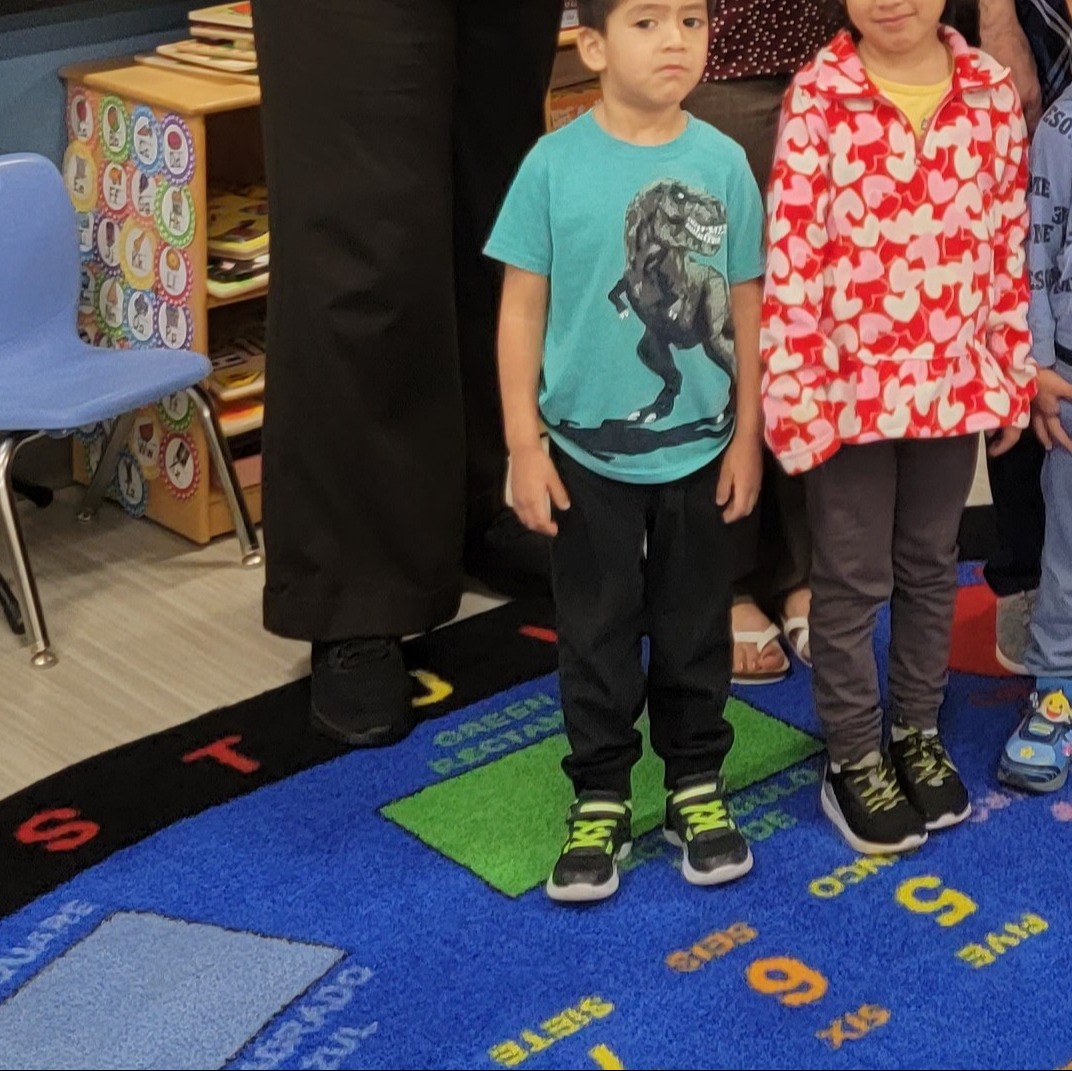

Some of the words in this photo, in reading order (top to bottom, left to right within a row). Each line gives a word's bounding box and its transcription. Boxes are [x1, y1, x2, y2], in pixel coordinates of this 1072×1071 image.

[181, 734, 260, 774] T
[15, 808, 100, 851] S
[895, 875, 978, 927] 5
[956, 912, 1049, 968] FIVE
[746, 955, 829, 1006] 6
[815, 1003, 892, 1050] SIX
